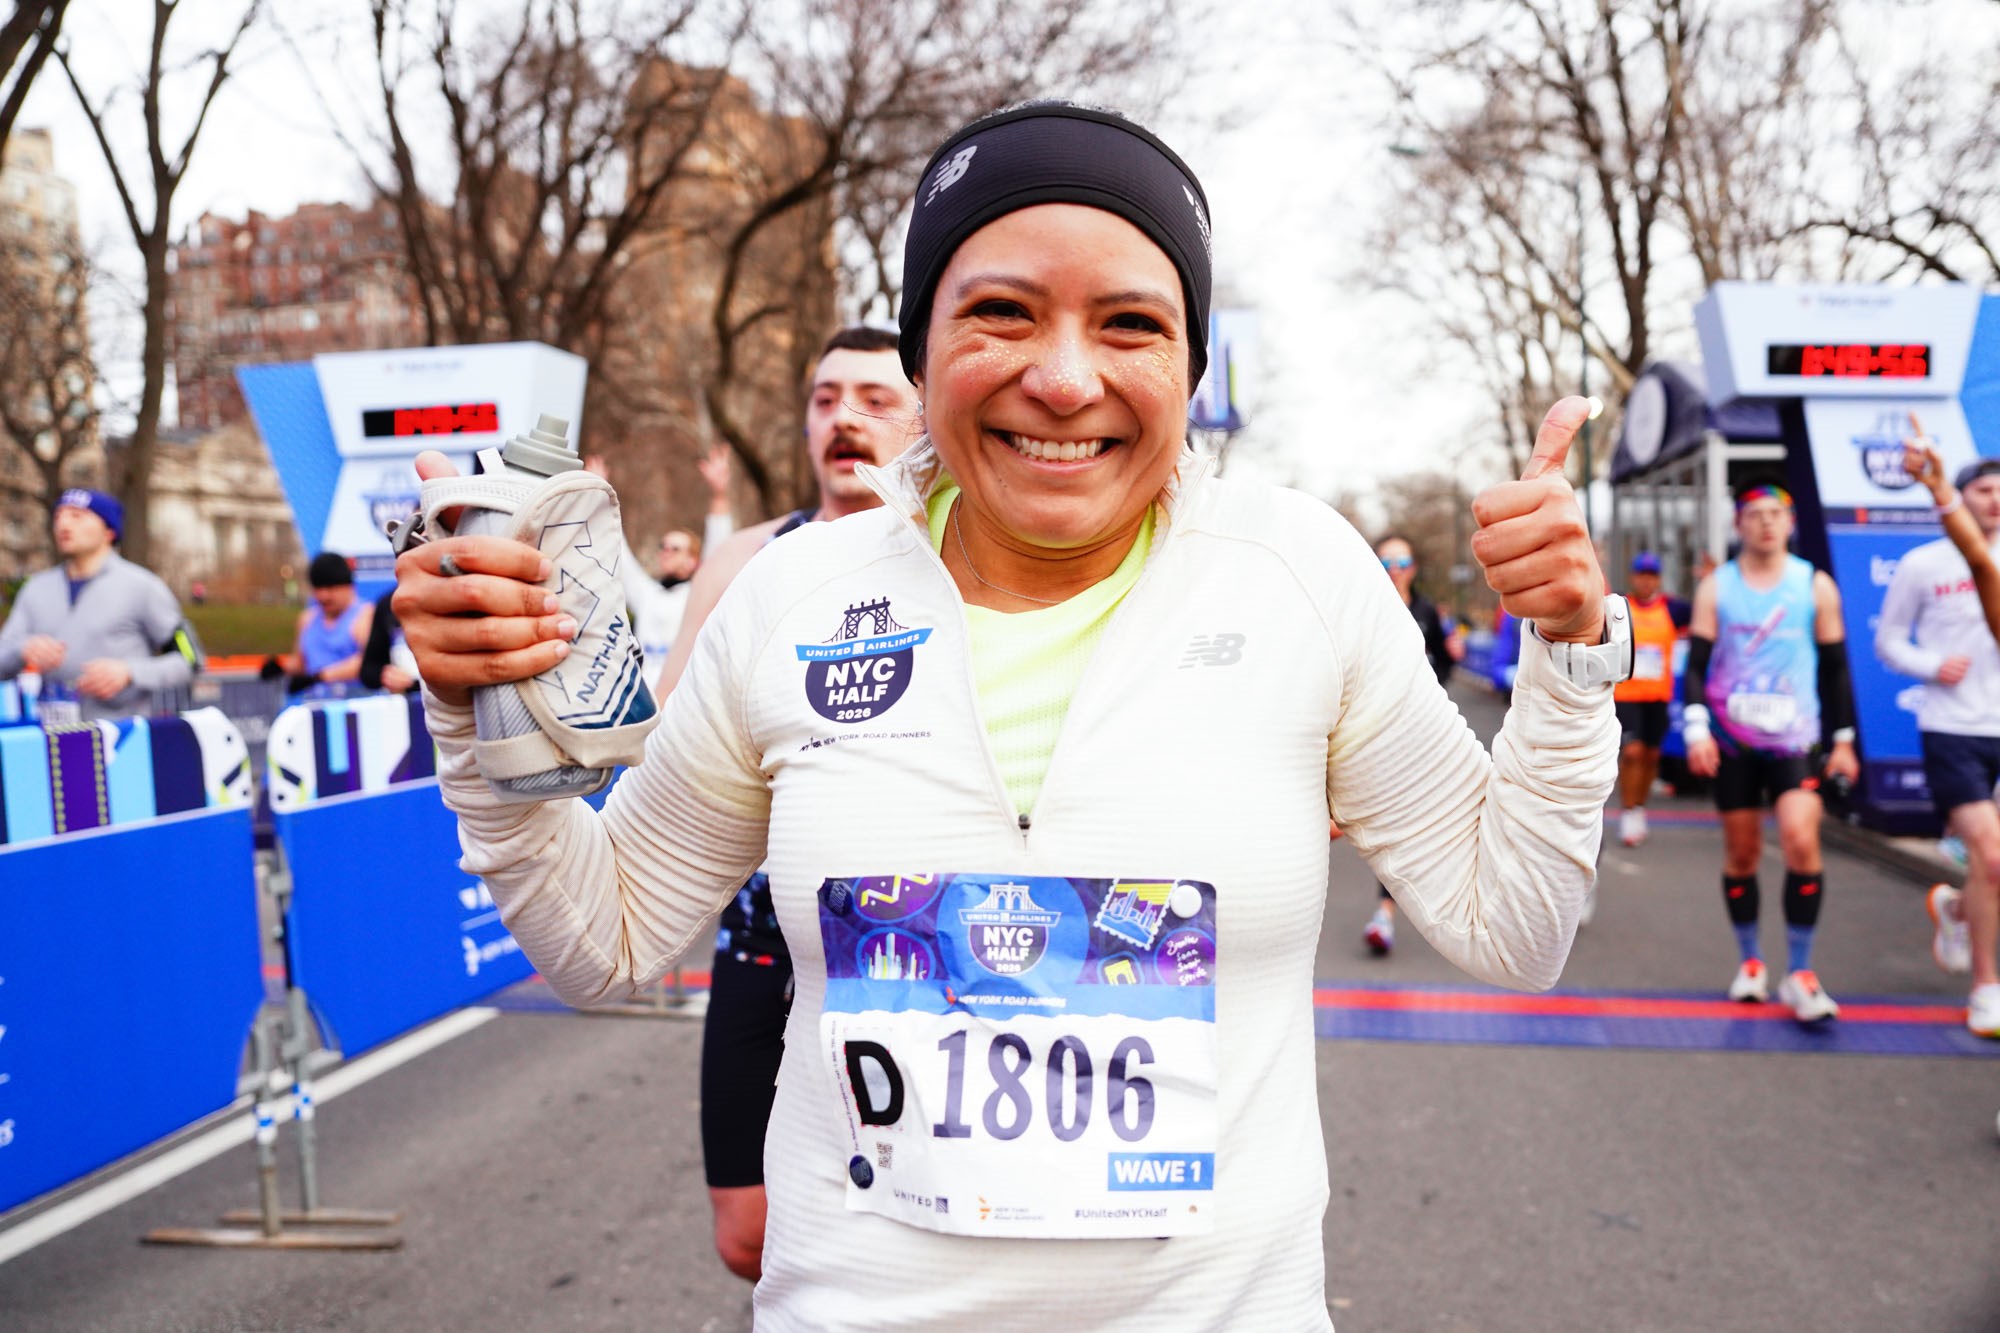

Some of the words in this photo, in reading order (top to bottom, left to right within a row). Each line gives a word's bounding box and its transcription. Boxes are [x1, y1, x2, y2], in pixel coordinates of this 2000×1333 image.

[805, 647, 851, 657] UNITED
[866, 633, 920, 651] AIRLINES
[576, 614, 624, 703] NATHAN
[825, 657, 896, 687] NYC
[827, 684, 888, 706] HALF
[836, 708, 871, 720] 2026
[823, 736, 837, 746] NEW
[890, 731, 932, 739] RUNNERS
[983, 926, 1033, 946] NYC
[986, 947, 1029, 961] HALF
[979, 995, 1002, 1005] YORK
[845, 1041, 904, 1126] D
[933, 1029, 1155, 1142] 1806
[1114, 1160, 1185, 1183] WAVE
[1190, 1161, 1202, 1183] 1
[894, 1188, 932, 1207] UNITED
[1074, 1207, 1168, 1219] #UnitedNYCHalf
